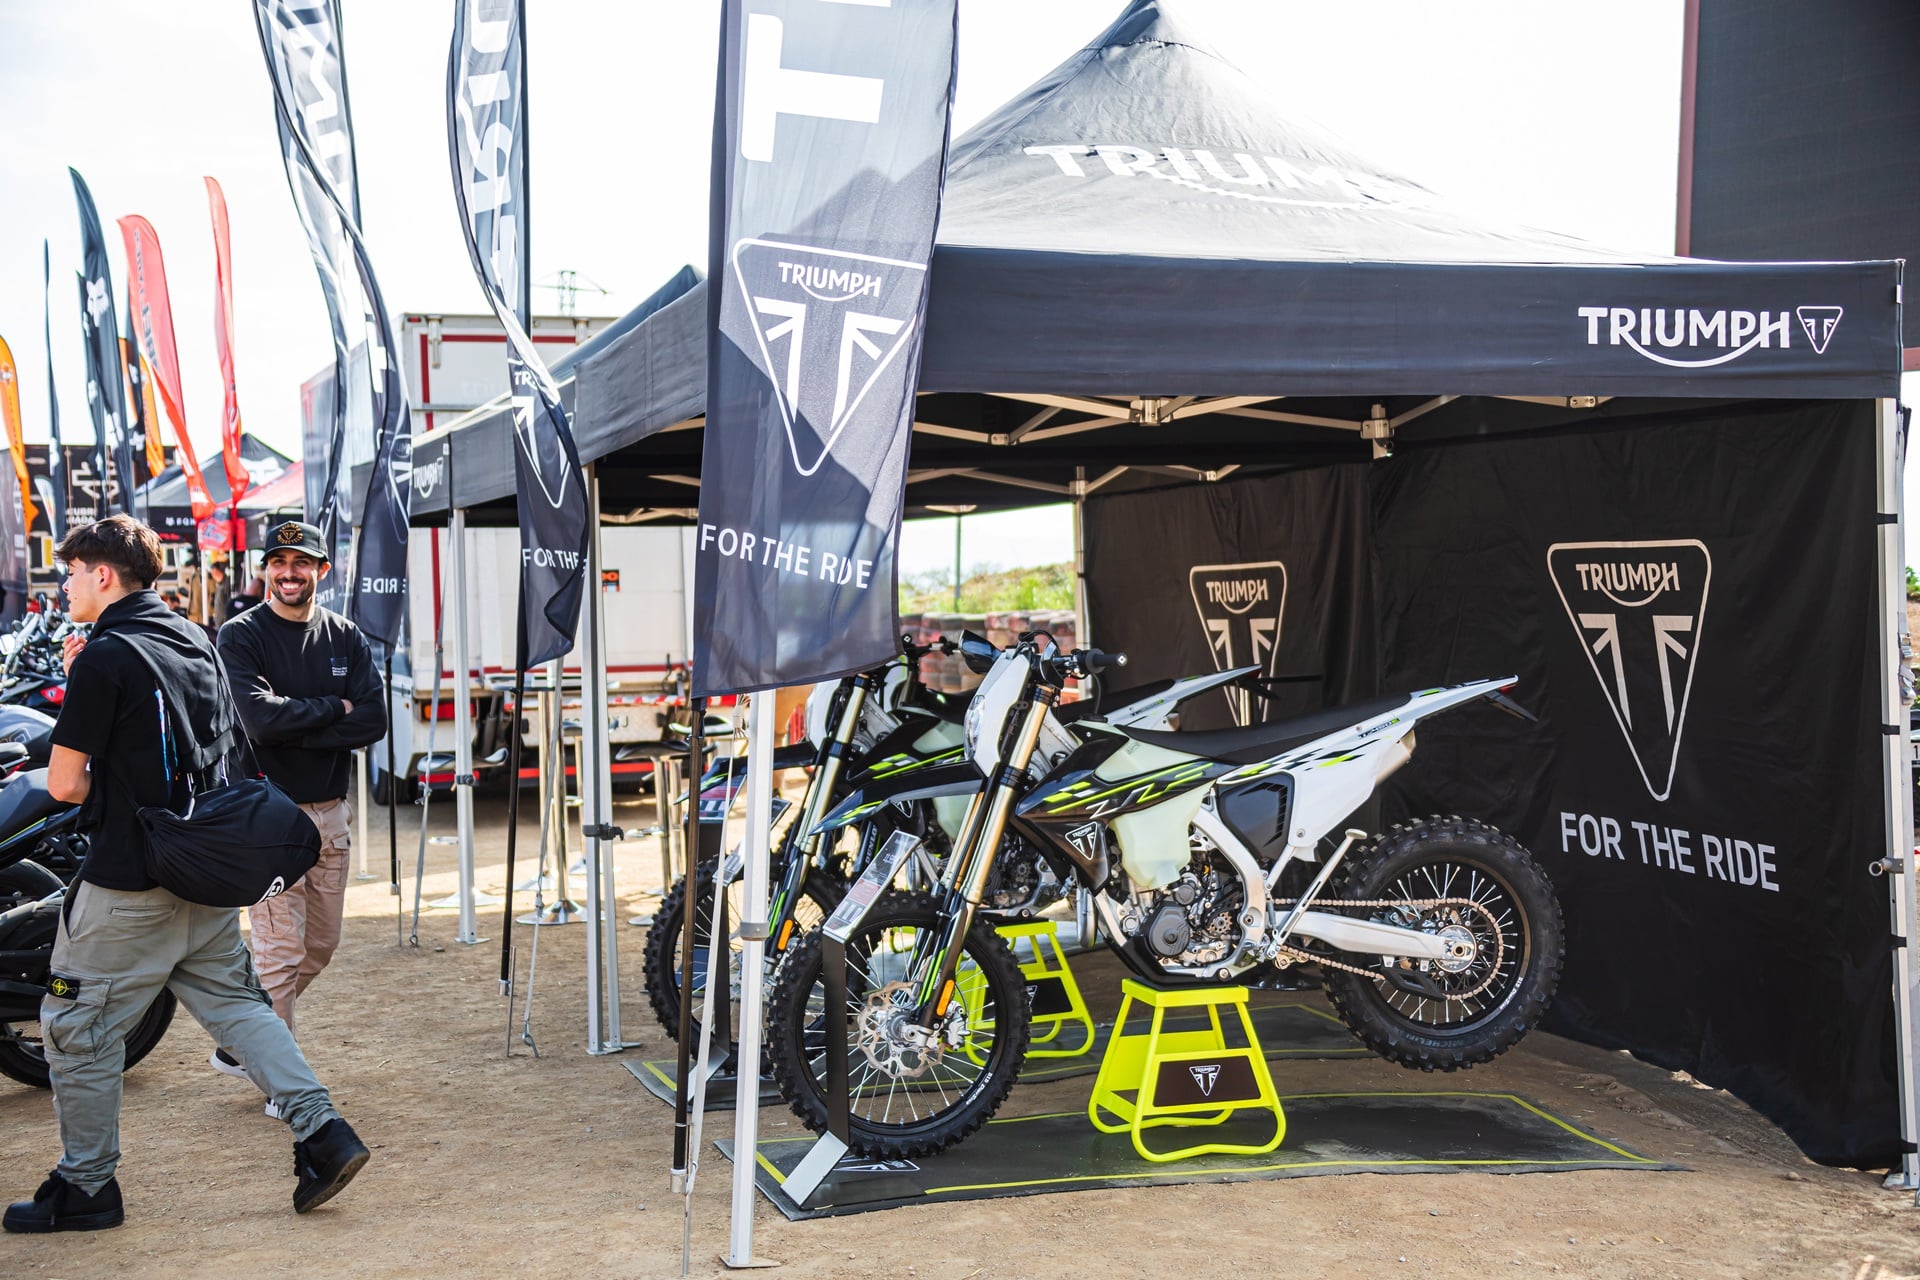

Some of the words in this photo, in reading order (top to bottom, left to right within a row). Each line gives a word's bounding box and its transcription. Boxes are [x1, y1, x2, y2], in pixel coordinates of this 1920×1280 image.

[741, 0, 891, 163] T
[1023, 144, 1400, 209] TRIUM
[778, 261, 882, 301] TRIUMPH
[1578, 307, 1790, 367] TRIUMPH
[522, 547, 556, 568] FOR
[700, 524, 756, 561] FOR
[762, 537, 811, 576] THE
[1206, 578, 1268, 614] TRIUMPH
[1576, 563, 1680, 607] TRIUMPH
[865, 824, 878, 864] DUNLO
[1560, 811, 1625, 861] FOR
[1631, 821, 1695, 874] THE
[1702, 833, 1779, 892] RIDE
